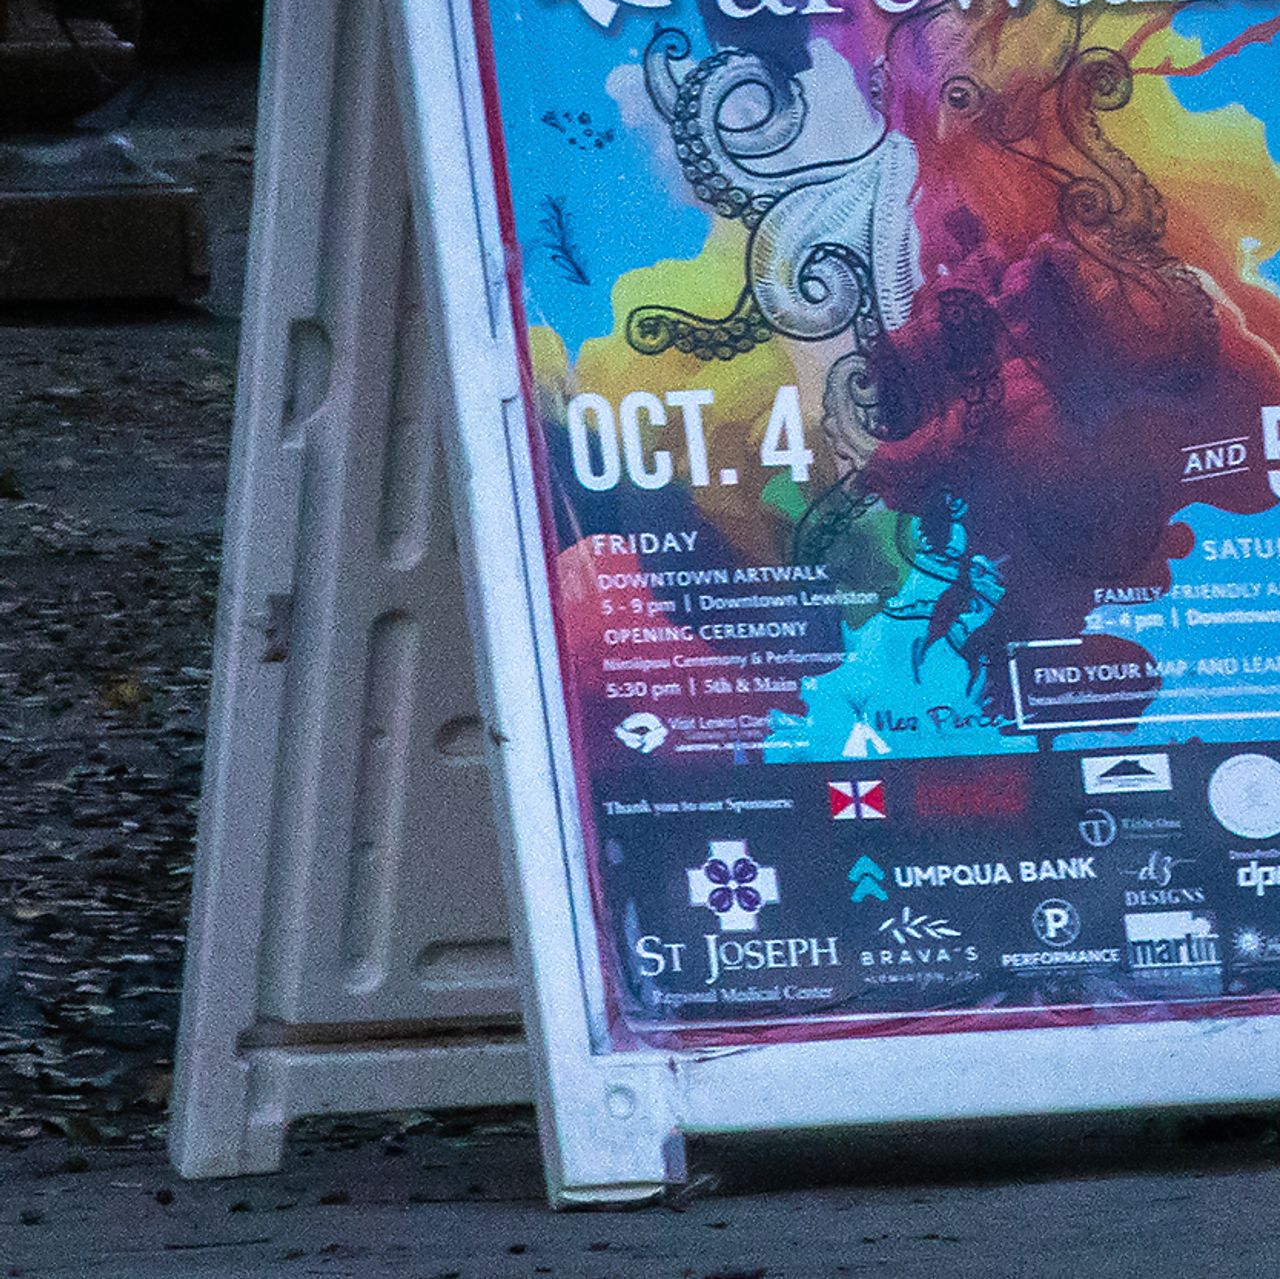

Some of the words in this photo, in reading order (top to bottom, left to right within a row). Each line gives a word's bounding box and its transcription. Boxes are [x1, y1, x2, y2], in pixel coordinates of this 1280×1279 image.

[567, 389, 738, 492] OCT.
[760, 385, 814, 482] 4
[1184, 443, 1247, 475] AND
[592, 531, 698, 556] FRIDAY
[597, 569, 728, 591] DOWNTOWN
[733, 564, 830, 584] ARTWALK
[602, 599, 613, 616] 5
[631, 598, 643, 615] 9
[647, 599, 676, 618] pm
[700, 593, 798, 612] Downtown
[801, 587, 880, 607] Lewiston
[603, 626, 695, 646] OPENING
[699, 621, 808, 641] CEREMONY
[1034, 668, 1081, 685] FIND
[1083, 664, 1141, 683] YOUR
[1197, 659, 1239, 676] AND
[606, 681, 648, 699] 5:30
[652, 682, 683, 701] pm
[754, 676, 798, 693] Main
[894, 862, 1013, 888] UMPQUA
[1019, 856, 1097, 883] BANK
[1125, 888, 1206, 907] DESIGNS
[636, 935, 687, 977] ST
[704, 934, 843, 986] JOSEPH
[1002, 948, 1120, 967] PERFORMANCE
